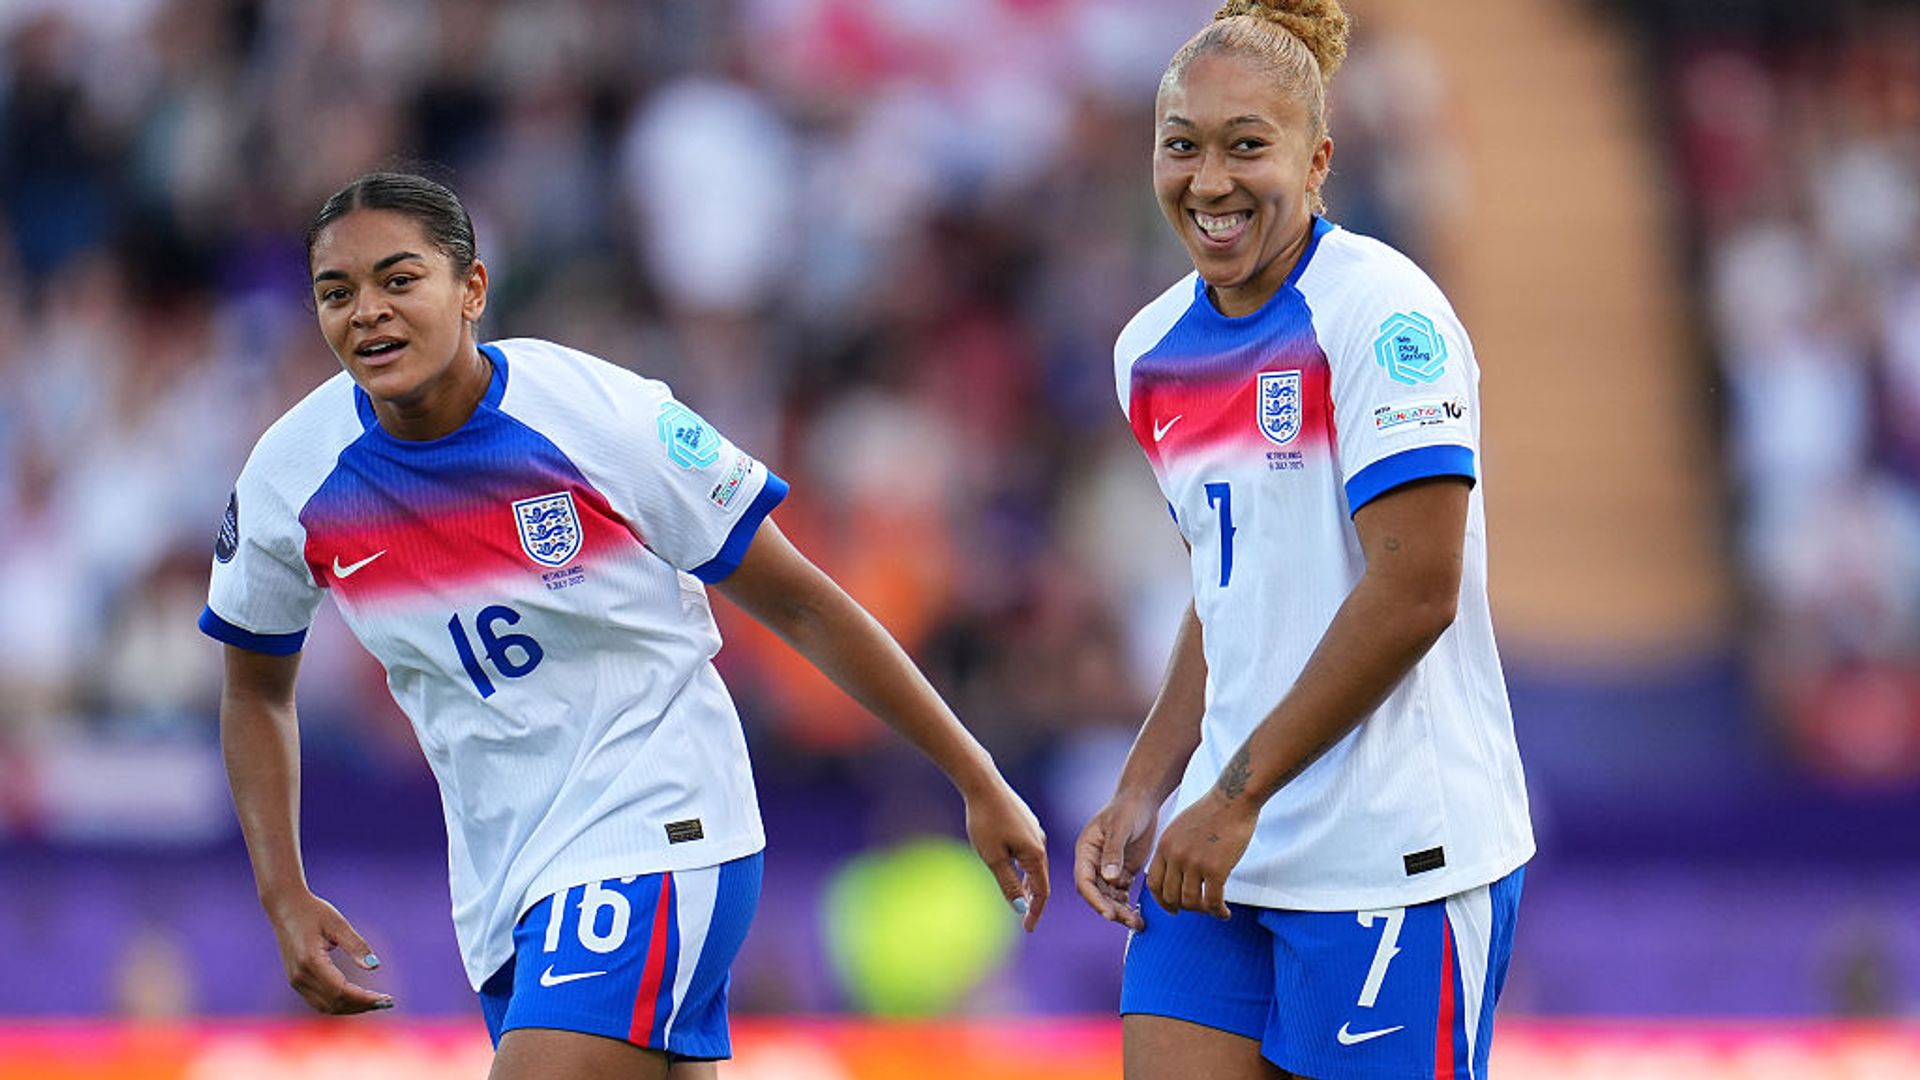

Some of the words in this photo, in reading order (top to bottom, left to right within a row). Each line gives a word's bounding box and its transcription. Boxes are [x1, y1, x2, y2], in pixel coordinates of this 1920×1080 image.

[1398, 345, 1418, 354] Play
[1400, 352, 1430, 361] Strong
[1376, 407, 1441, 426] FOUNDATION
[1204, 482, 1237, 588] 7
[448, 605, 544, 699] 16
[543, 877, 635, 953] 16
[1357, 908, 1405, 1008] 7
